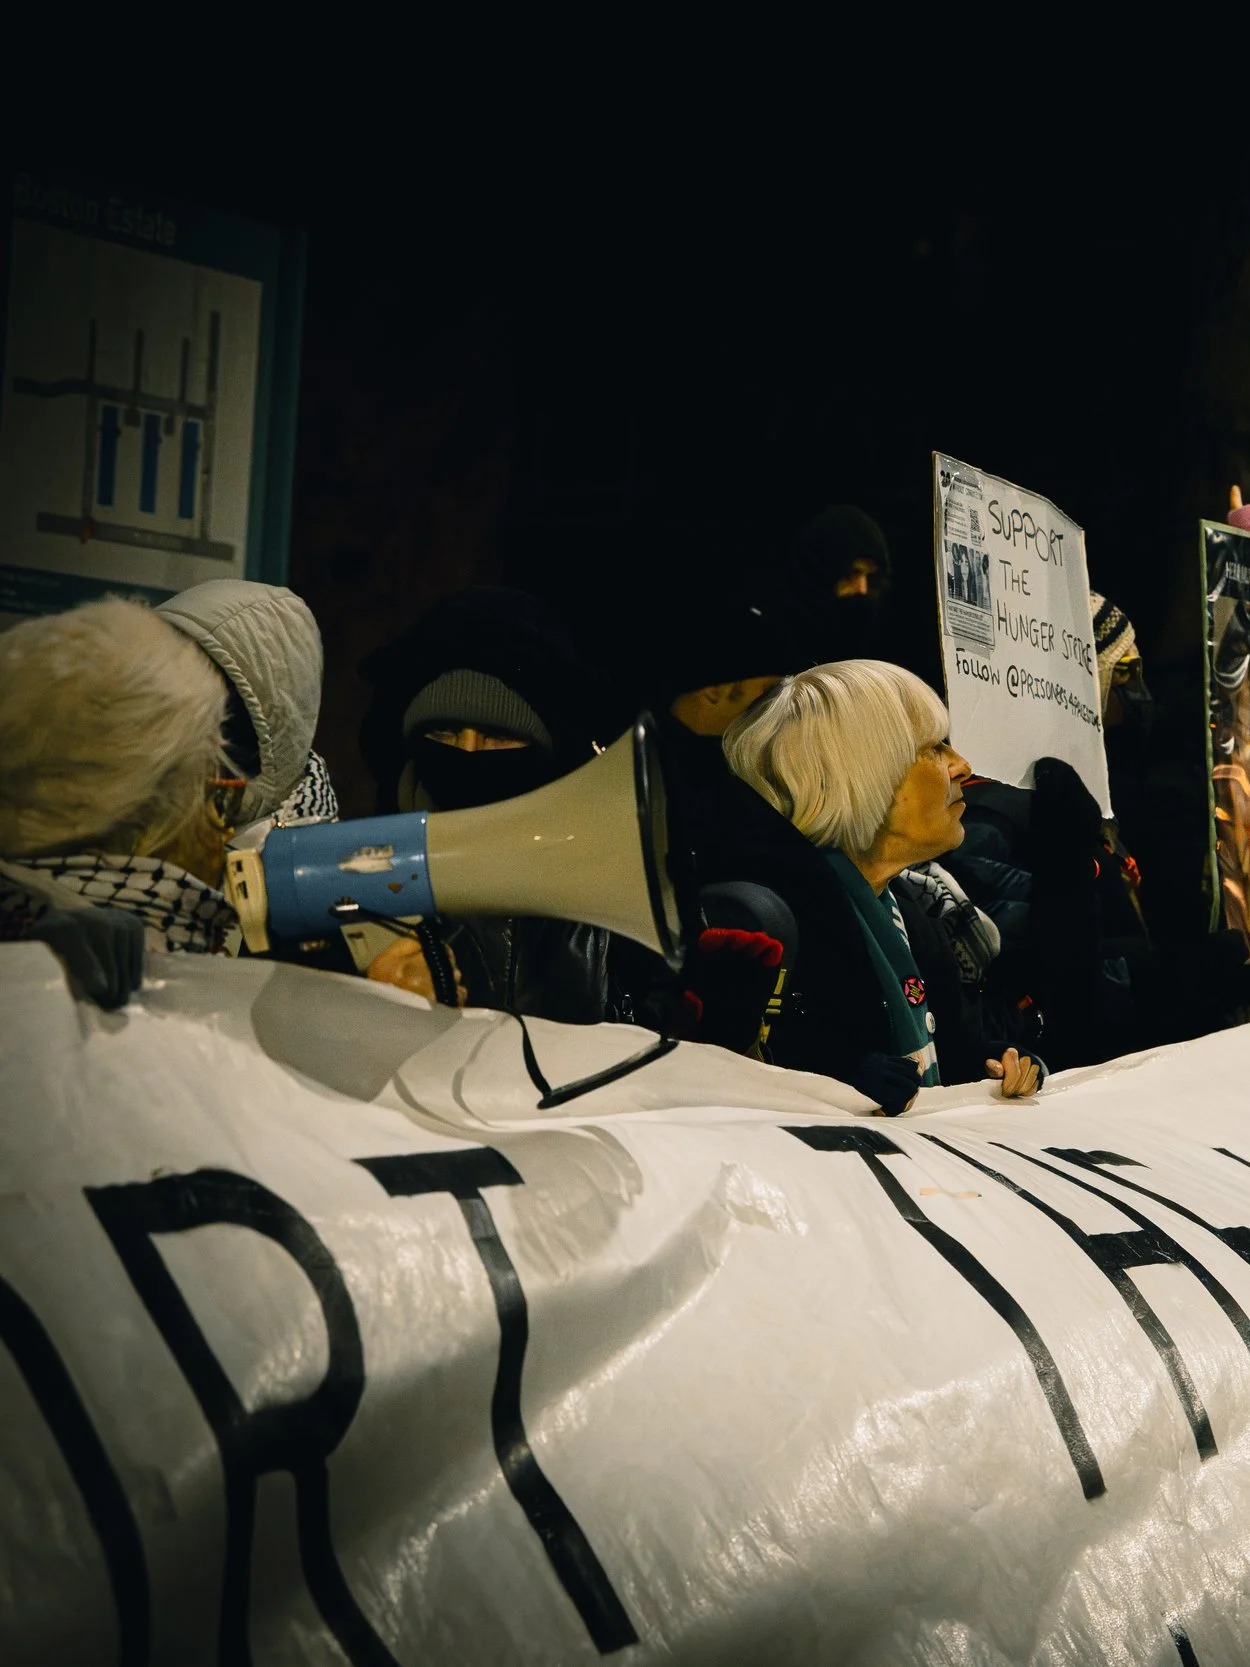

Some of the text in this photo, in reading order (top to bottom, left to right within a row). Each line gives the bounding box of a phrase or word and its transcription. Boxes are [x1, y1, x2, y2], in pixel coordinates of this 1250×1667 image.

[107, 196, 177, 247] Estate
[988, 499, 1063, 567] SUPPORT
[999, 559, 1031, 596] THE
[996, 598, 1055, 652] HUNGER
[1061, 619, 1094, 677] STRIKE
[955, 647, 1001, 686] FOLLOW
